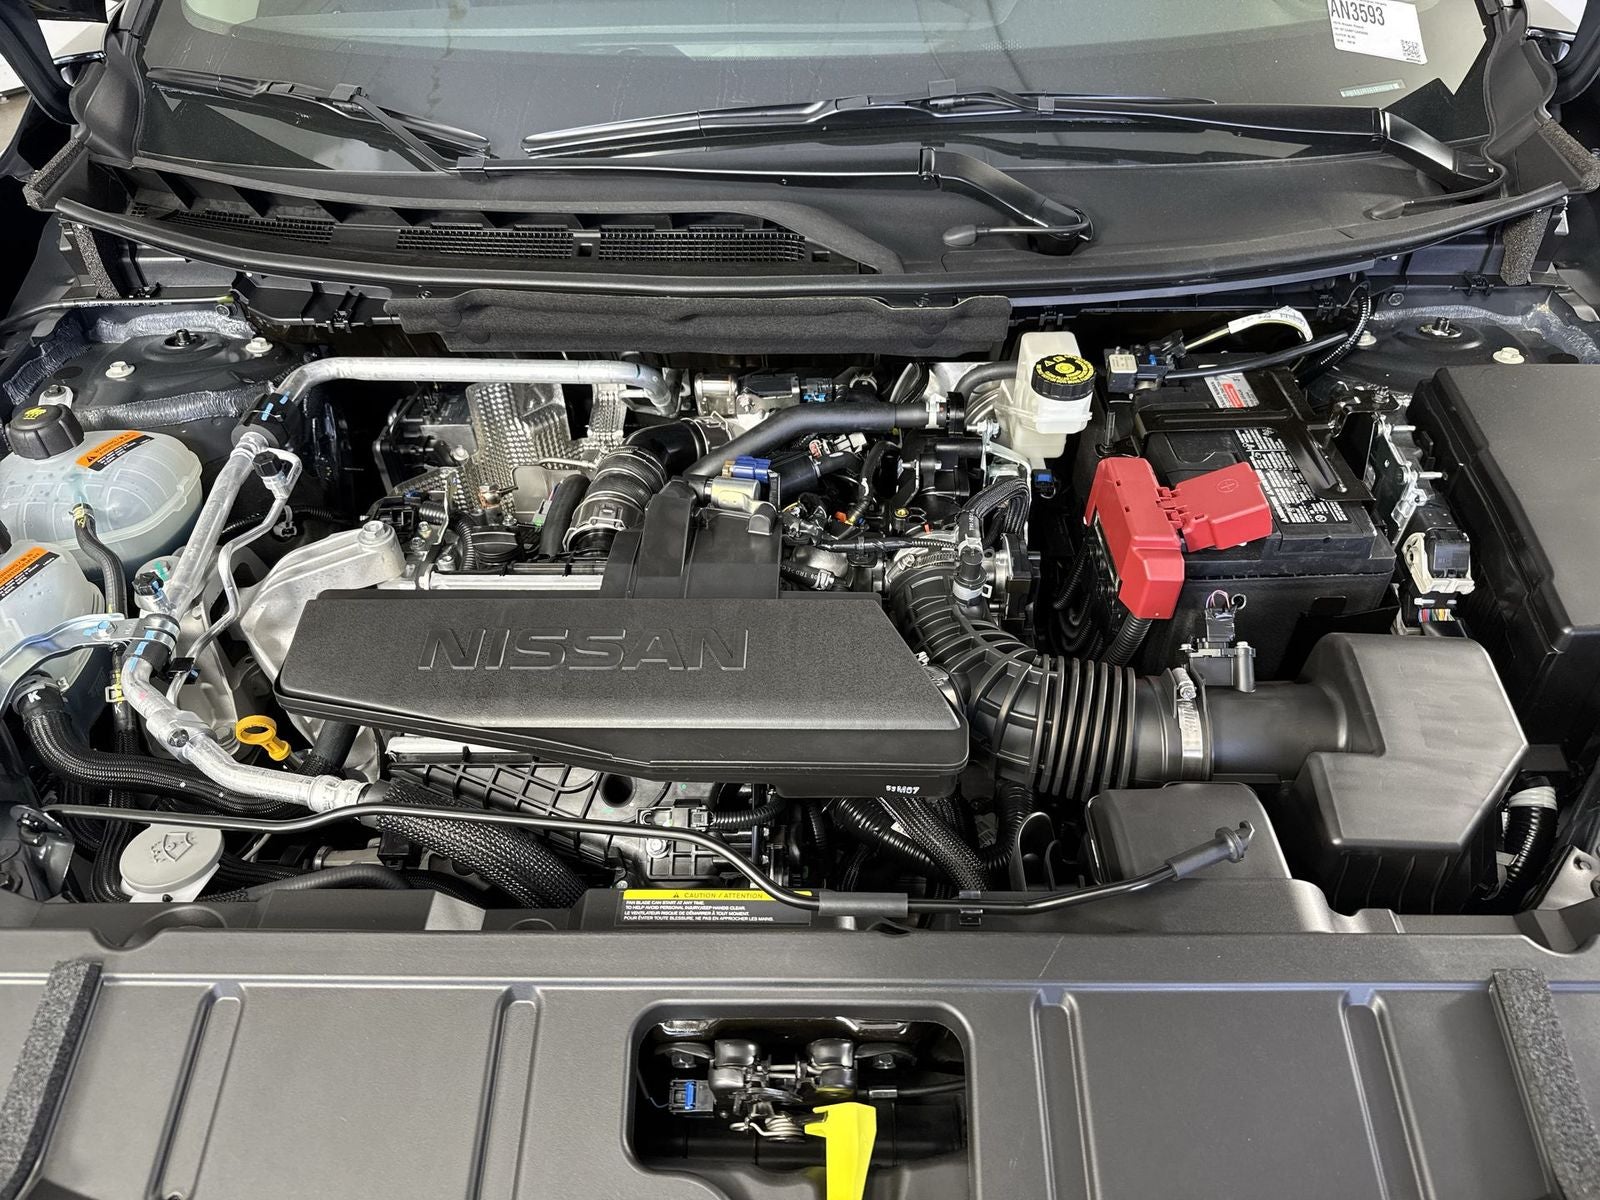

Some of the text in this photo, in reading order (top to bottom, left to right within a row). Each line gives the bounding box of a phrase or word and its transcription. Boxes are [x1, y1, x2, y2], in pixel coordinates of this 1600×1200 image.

[1331, 0, 1385, 26] AN3593
[418, 628, 749, 671] NISSAN
[27, 690, 41, 703] K
[724, 892, 764, 900] ATTENTION
